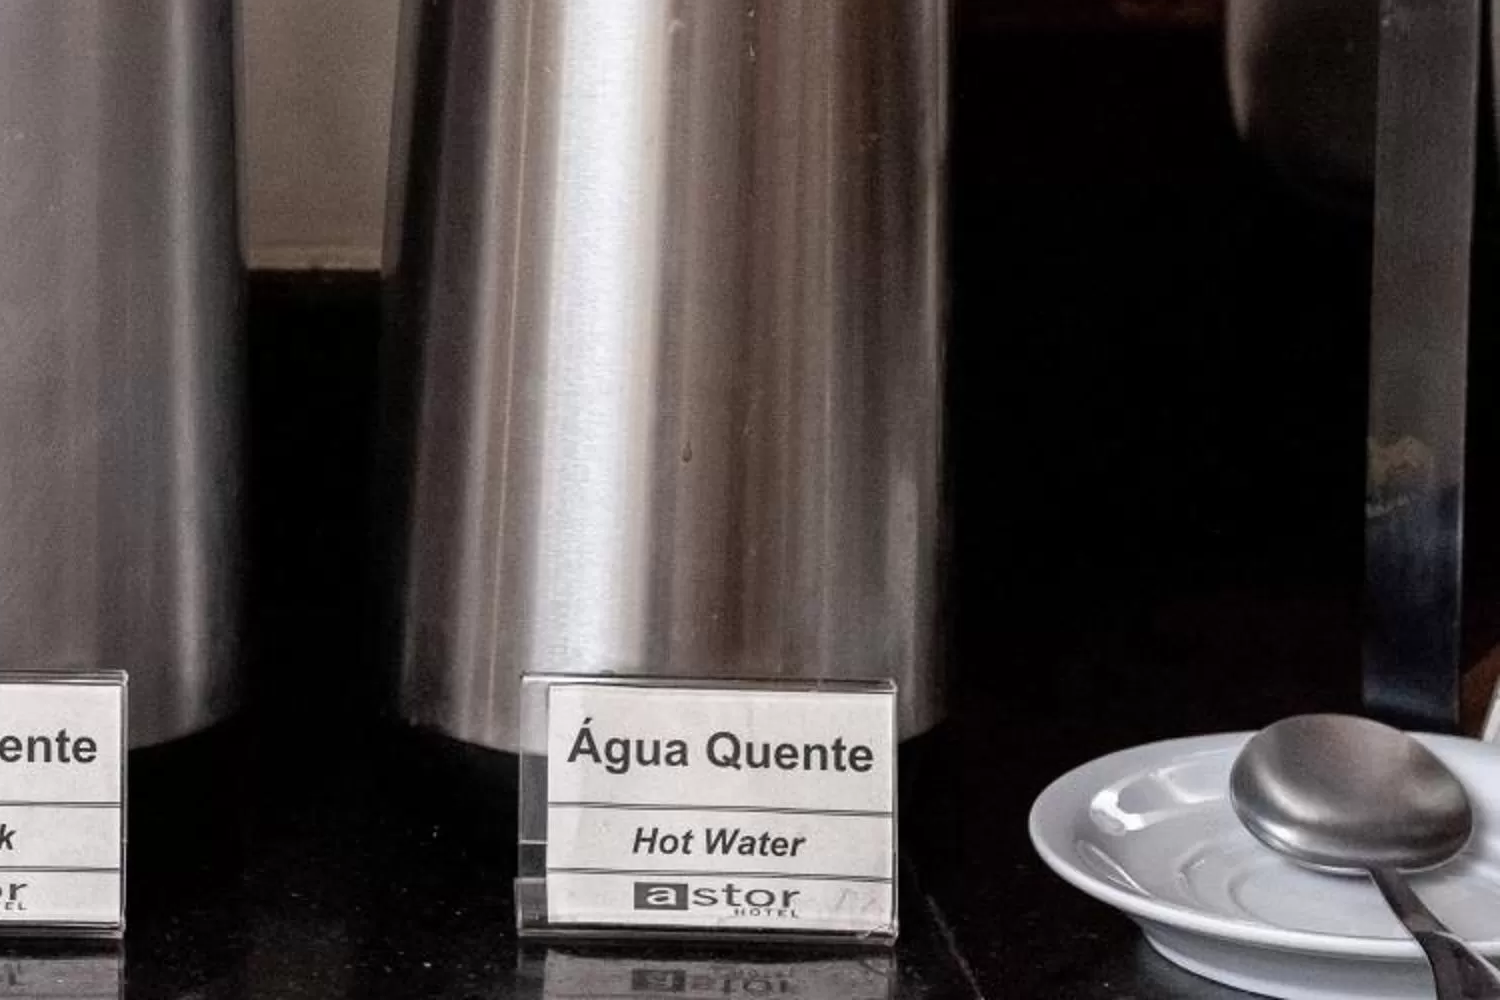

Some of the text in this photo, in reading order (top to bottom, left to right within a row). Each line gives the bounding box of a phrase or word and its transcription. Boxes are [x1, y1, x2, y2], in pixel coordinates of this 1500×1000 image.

[567, 717, 874, 774] Água Quente
[632, 827, 806, 857] Hot Water
[633, 882, 801, 910] astor
[734, 908, 799, 919] HOTEL
